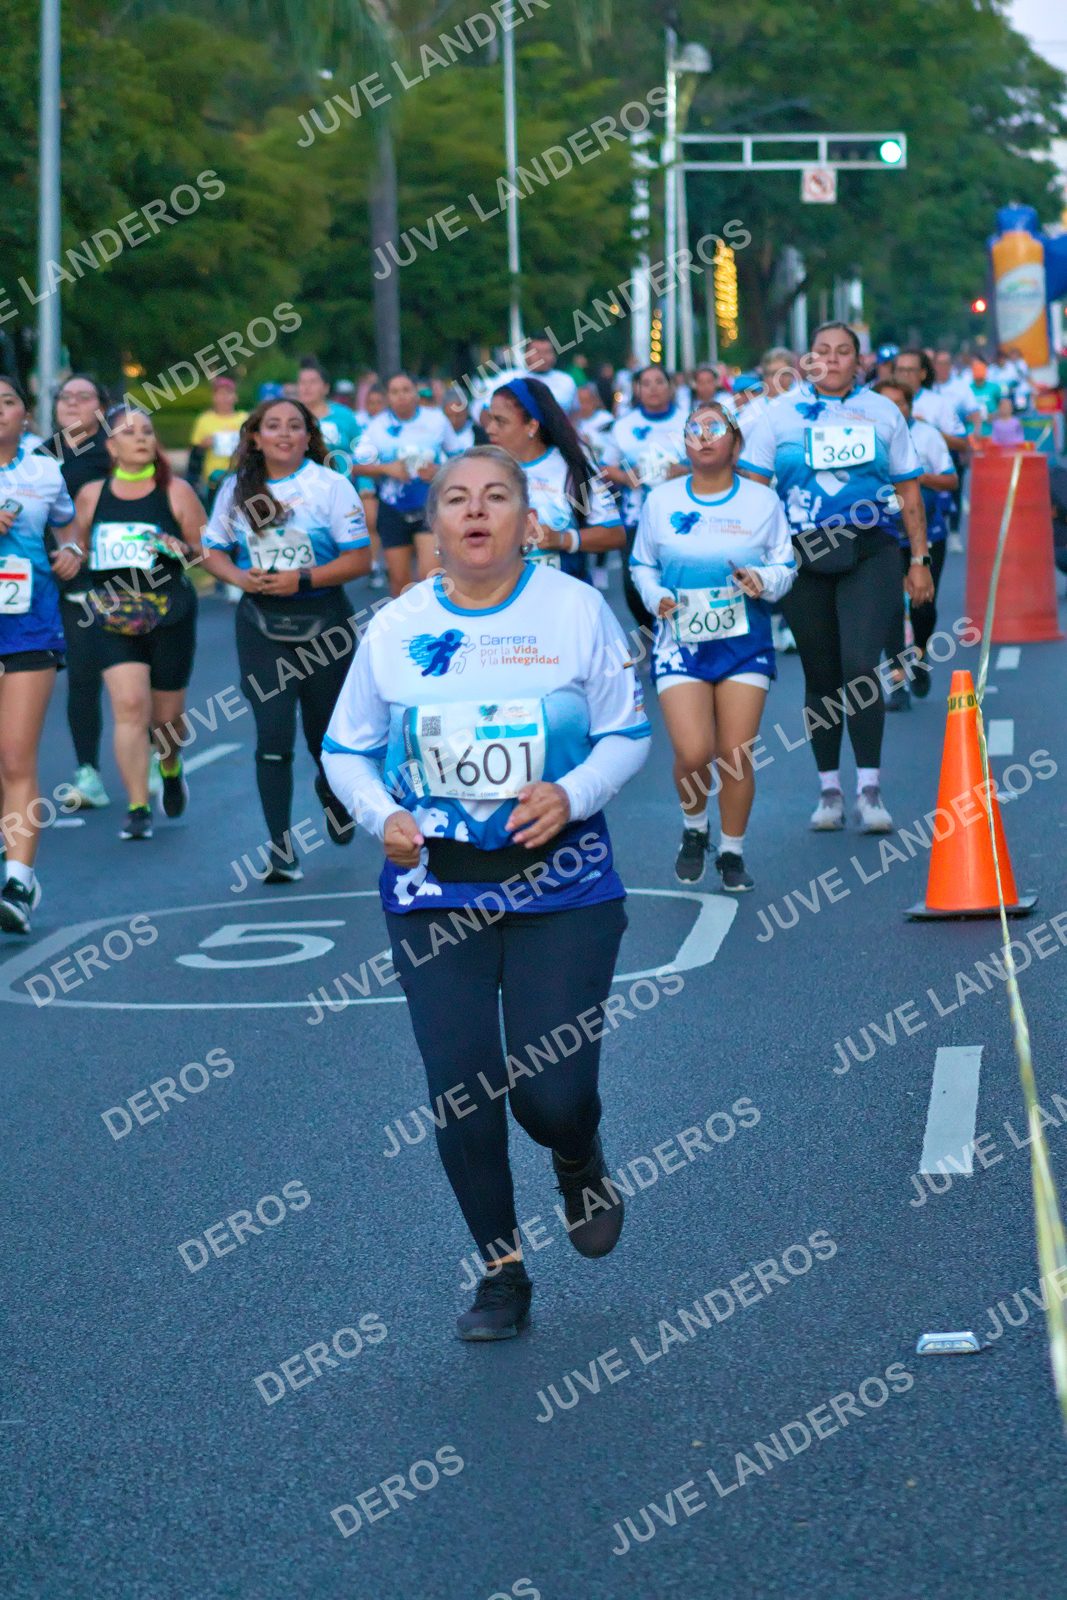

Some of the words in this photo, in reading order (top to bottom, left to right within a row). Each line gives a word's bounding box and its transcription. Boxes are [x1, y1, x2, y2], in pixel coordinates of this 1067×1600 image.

[823, 443, 865, 463] 360
[255, 544, 313, 570] 1793
[689, 608, 736, 635] 603
[480, 635, 536, 646] Carrera
[481, 648, 497, 657] por
[502, 647, 511, 655] la
[513, 645, 538, 655] Vida
[489, 657, 498, 665] la
[502, 656, 560, 666] Integridad
[429, 741, 533, 787] 1601
[176, 920, 345, 969] 5
